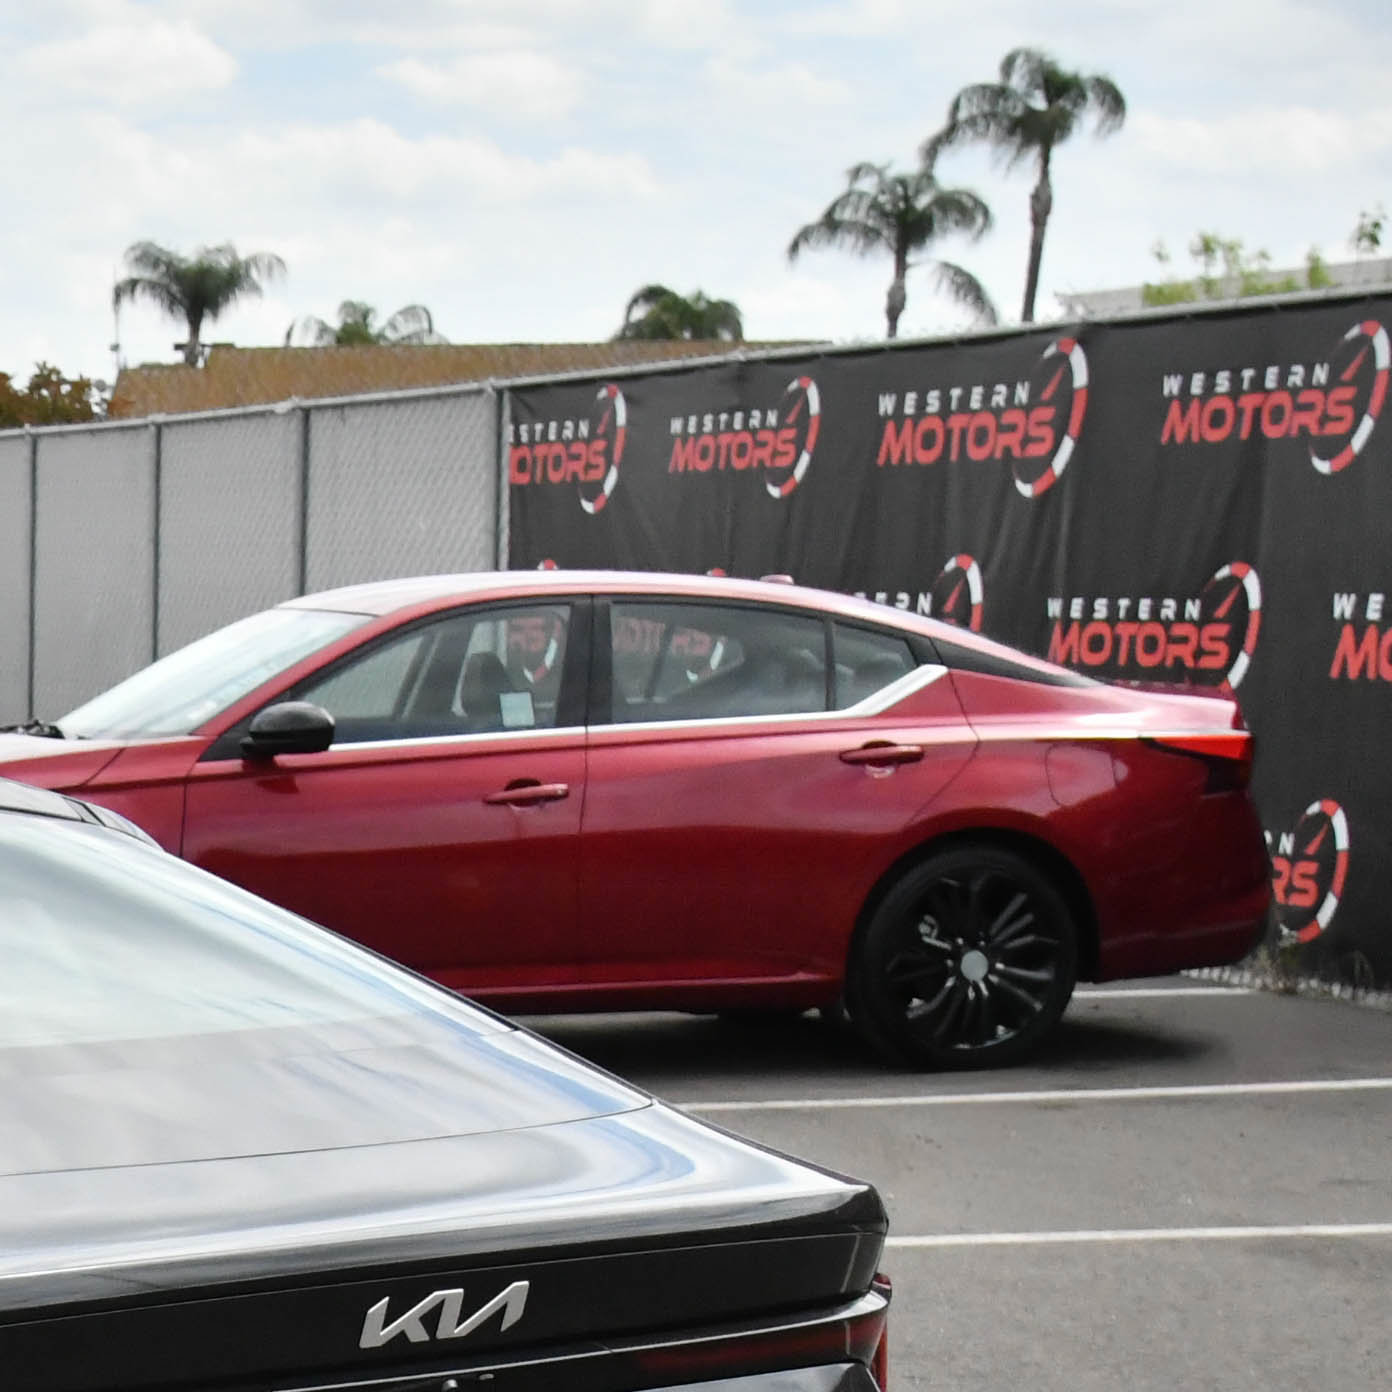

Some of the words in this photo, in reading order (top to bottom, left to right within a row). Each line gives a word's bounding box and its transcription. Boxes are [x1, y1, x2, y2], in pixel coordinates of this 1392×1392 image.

[878, 381, 1031, 416] WESTERN
[1163, 363, 1330, 397] WESTERN
[509, 419, 590, 443] STERN
[670, 409, 778, 435] WESTERN
[876, 406, 1056, 467] MOTORS
[1160, 386, 1358, 445] MOTORS
[509, 439, 608, 485] OTORS
[668, 428, 798, 473] MOTORS
[1047, 597, 1202, 621] WESTERN
[1047, 620, 1231, 669] MOTORS
[359, 1280, 530, 1349] KIA
